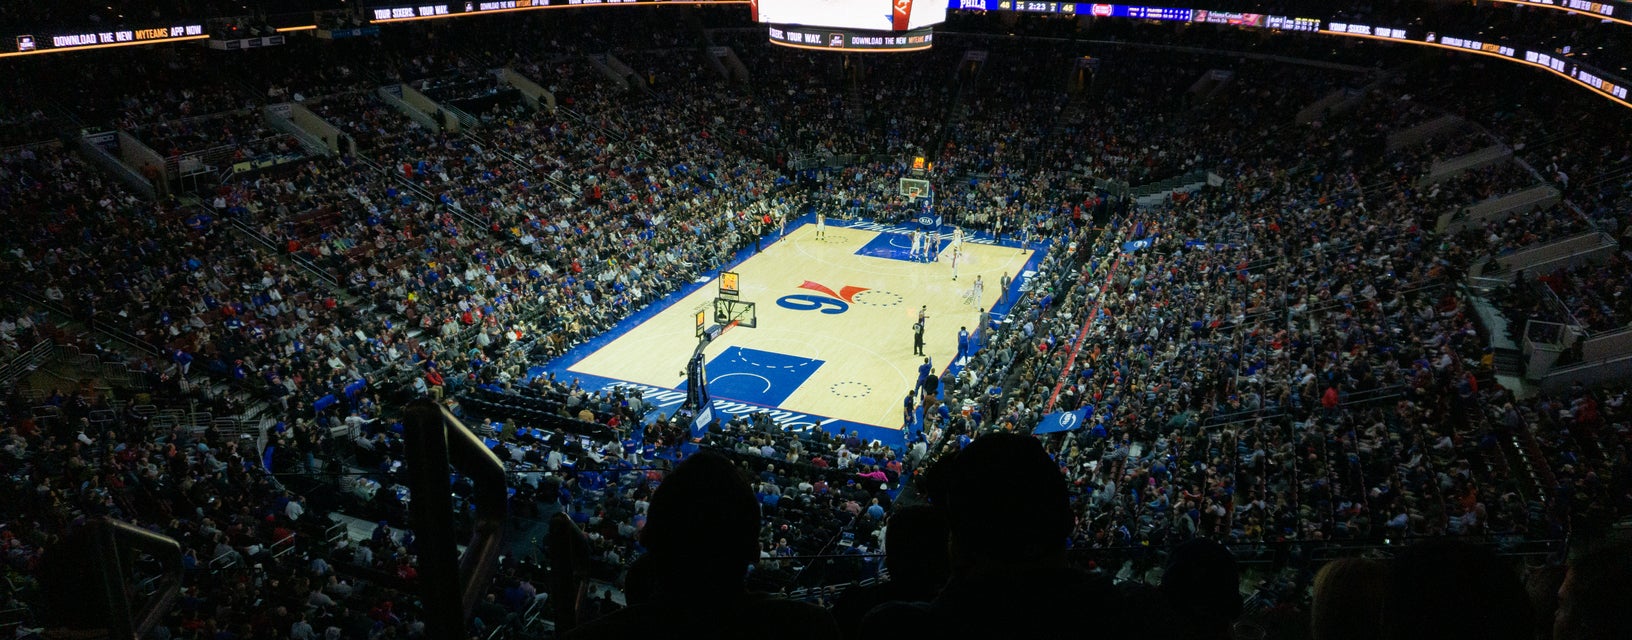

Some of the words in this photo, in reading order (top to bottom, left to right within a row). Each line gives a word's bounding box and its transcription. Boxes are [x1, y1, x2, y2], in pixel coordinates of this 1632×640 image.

[960, 0, 986, 9] PHILA
[1062, 4, 1074, 12] 45
[374, 8, 391, 20] YOUR
[419, 6, 434, 16] YOUR
[53, 33, 97, 47] DOWNLOAD
[99, 32, 114, 43] THE
[116, 30, 133, 41] NEW
[135, 28, 168, 40] MYTEAMS
[170, 26, 184, 37] APP
[186, 25, 201, 35] NOW
[787, 31, 802, 42] YOUR
[804, 33, 822, 44] WAY.
[851, 36, 883, 45] DOWNLOAD
[885, 37, 894, 45] THE
[896, 37, 907, 45] NEW
